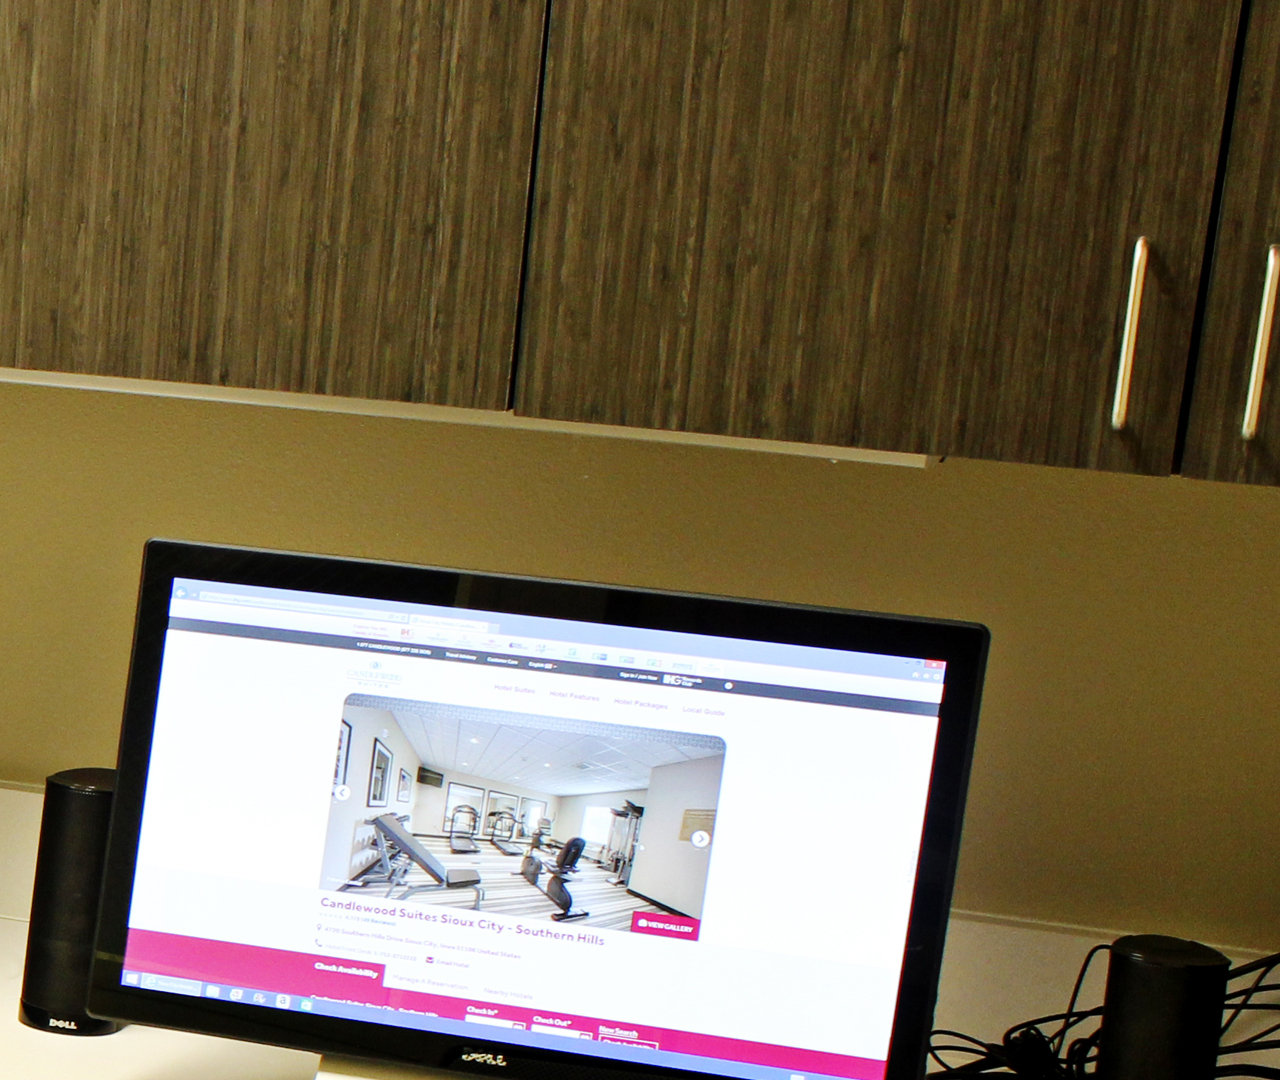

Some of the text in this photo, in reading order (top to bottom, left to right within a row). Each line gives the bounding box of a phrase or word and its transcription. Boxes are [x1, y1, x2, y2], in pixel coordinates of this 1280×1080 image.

[320, 897, 397, 917] Candlewood
[399, 908, 438, 922] Suites
[440, 914, 475, 927] Sioux
[478, 919, 504, 934] City
[515, 924, 574, 943] Southern
[577, 930, 605, 946] Hills
[314, 962, 337, 972] Check
[48, 1018, 78, 1030] DELL
